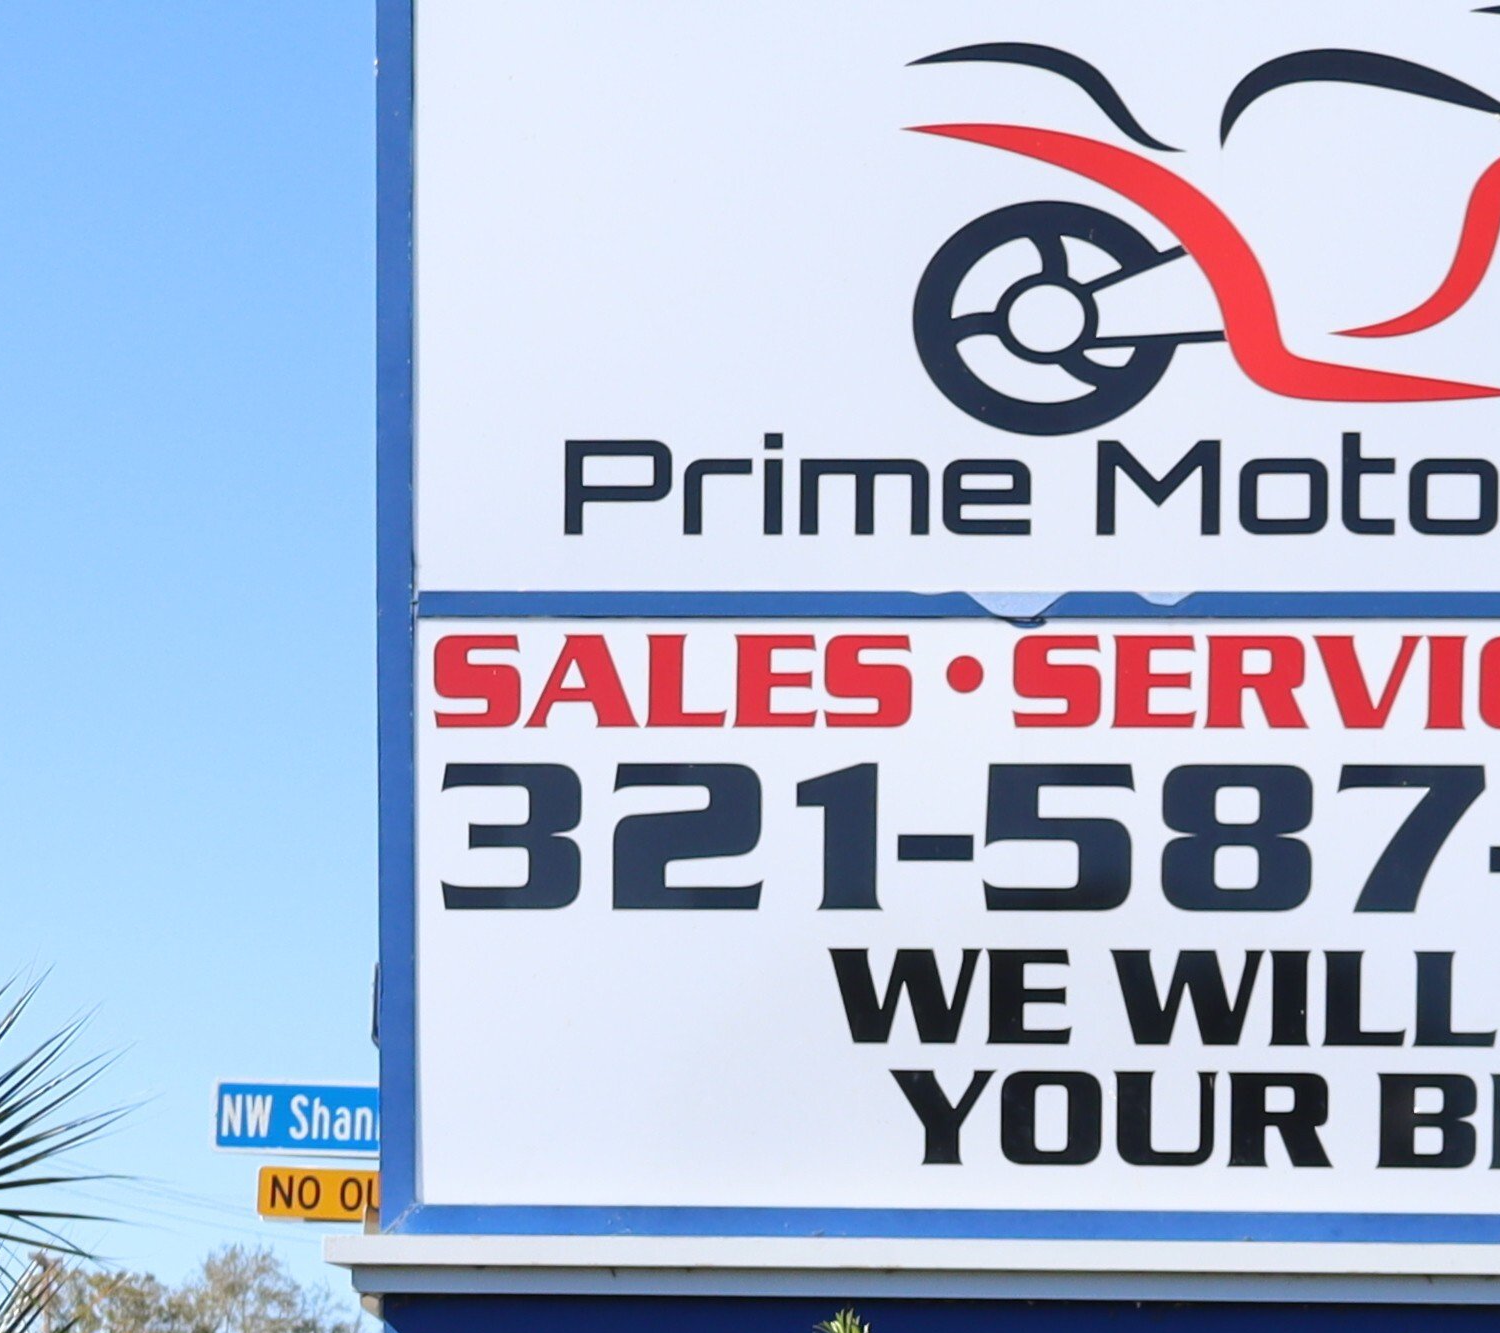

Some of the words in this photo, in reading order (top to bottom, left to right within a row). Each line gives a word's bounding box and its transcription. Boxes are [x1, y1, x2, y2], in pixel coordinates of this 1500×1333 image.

[563, 433, 1034, 538] Prime
[432, 634, 912, 730] SALES
[829, 947, 1070, 1045] WE
[1113, 949, 1498, 1048] WILL
[221, 1094, 273, 1137] NW
[288, 1094, 379, 1141] Shan
[890, 1071, 1336, 1169] YOUR
[270, 1174, 320, 1209] NO
